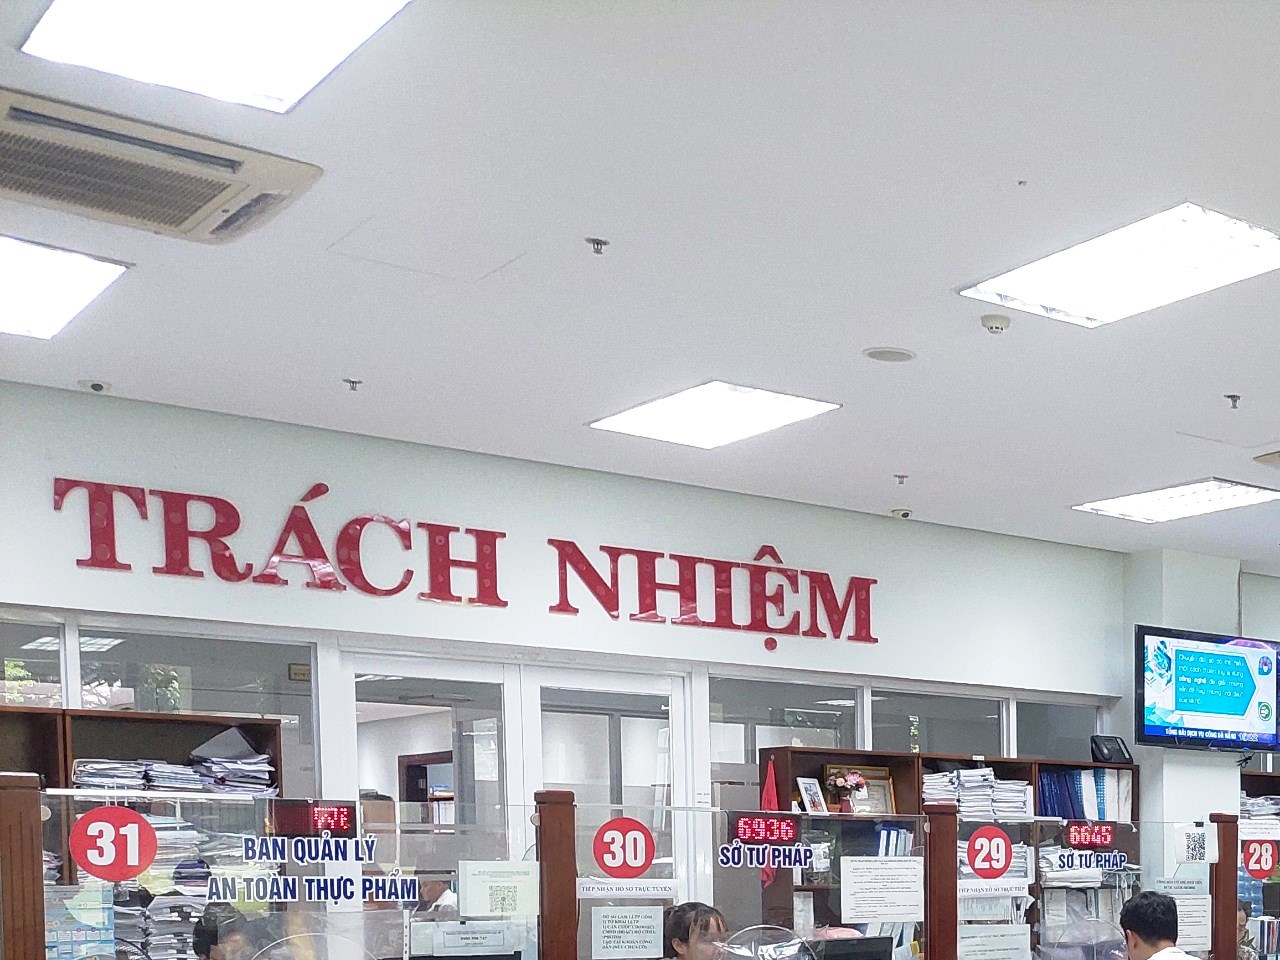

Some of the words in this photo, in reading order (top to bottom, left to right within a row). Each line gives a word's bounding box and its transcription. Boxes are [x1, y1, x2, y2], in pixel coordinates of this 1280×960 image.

[53, 482, 508, 608] TRÁCH
[548, 538, 879, 651] NHIỆM
[87, 822, 139, 867] 31
[244, 838, 286, 861] BAN
[294, 831, 347, 863] QUẢN
[355, 834, 375, 861] LÝ
[603, 829, 645, 864] 30
[1070, 826, 1111, 844] 6645
[720, 840, 742, 866] SỞ
[747, 846, 770, 866] TƯ
[772, 843, 814, 867] PHÁP
[974, 838, 1006, 869] 29
[1058, 849, 1074, 869] SỞ
[1077, 853, 1094, 869] TƯ
[1096, 850, 1127, 869] PHÁP
[1249, 842, 1272, 871] 28
[208, 878, 237, 900] AN
[244, 873, 297, 900] TOÀN
[305, 877, 354, 905] THỰC
[362, 869, 417, 900] PHẨM
